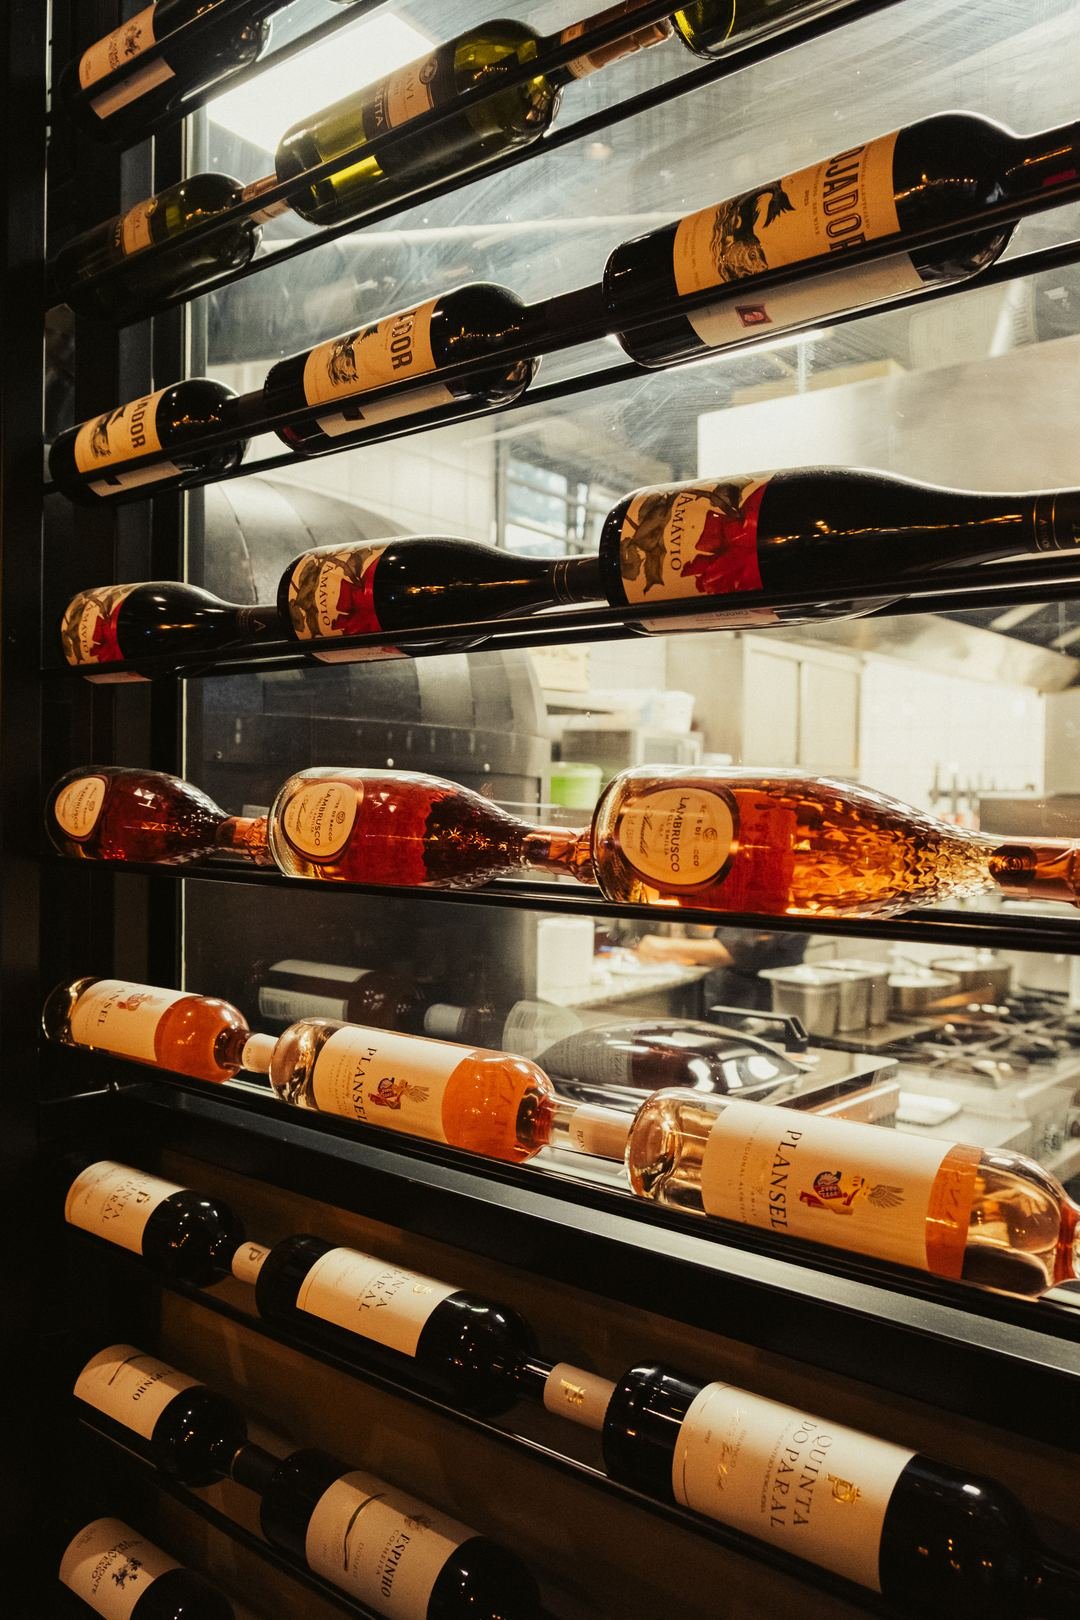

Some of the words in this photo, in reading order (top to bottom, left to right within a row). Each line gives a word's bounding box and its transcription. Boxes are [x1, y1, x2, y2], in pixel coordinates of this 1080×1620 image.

[670, 494, 694, 571] AMAVIO
[81, 603, 98, 653] AMAVIO
[320, 564, 334, 626] AMAVIO
[315, 788, 335, 846] LAMBRUSCO
[670, 797, 690, 872] LAMBRUSCO
[768, 1130, 803, 1229] PLANSEL
[792, 1420, 817, 1444] DO
[770, 1448, 799, 1528] PARAL
[793, 1435, 832, 1525] QUINTA
[381, 1533, 411, 1598] ESPINHO
